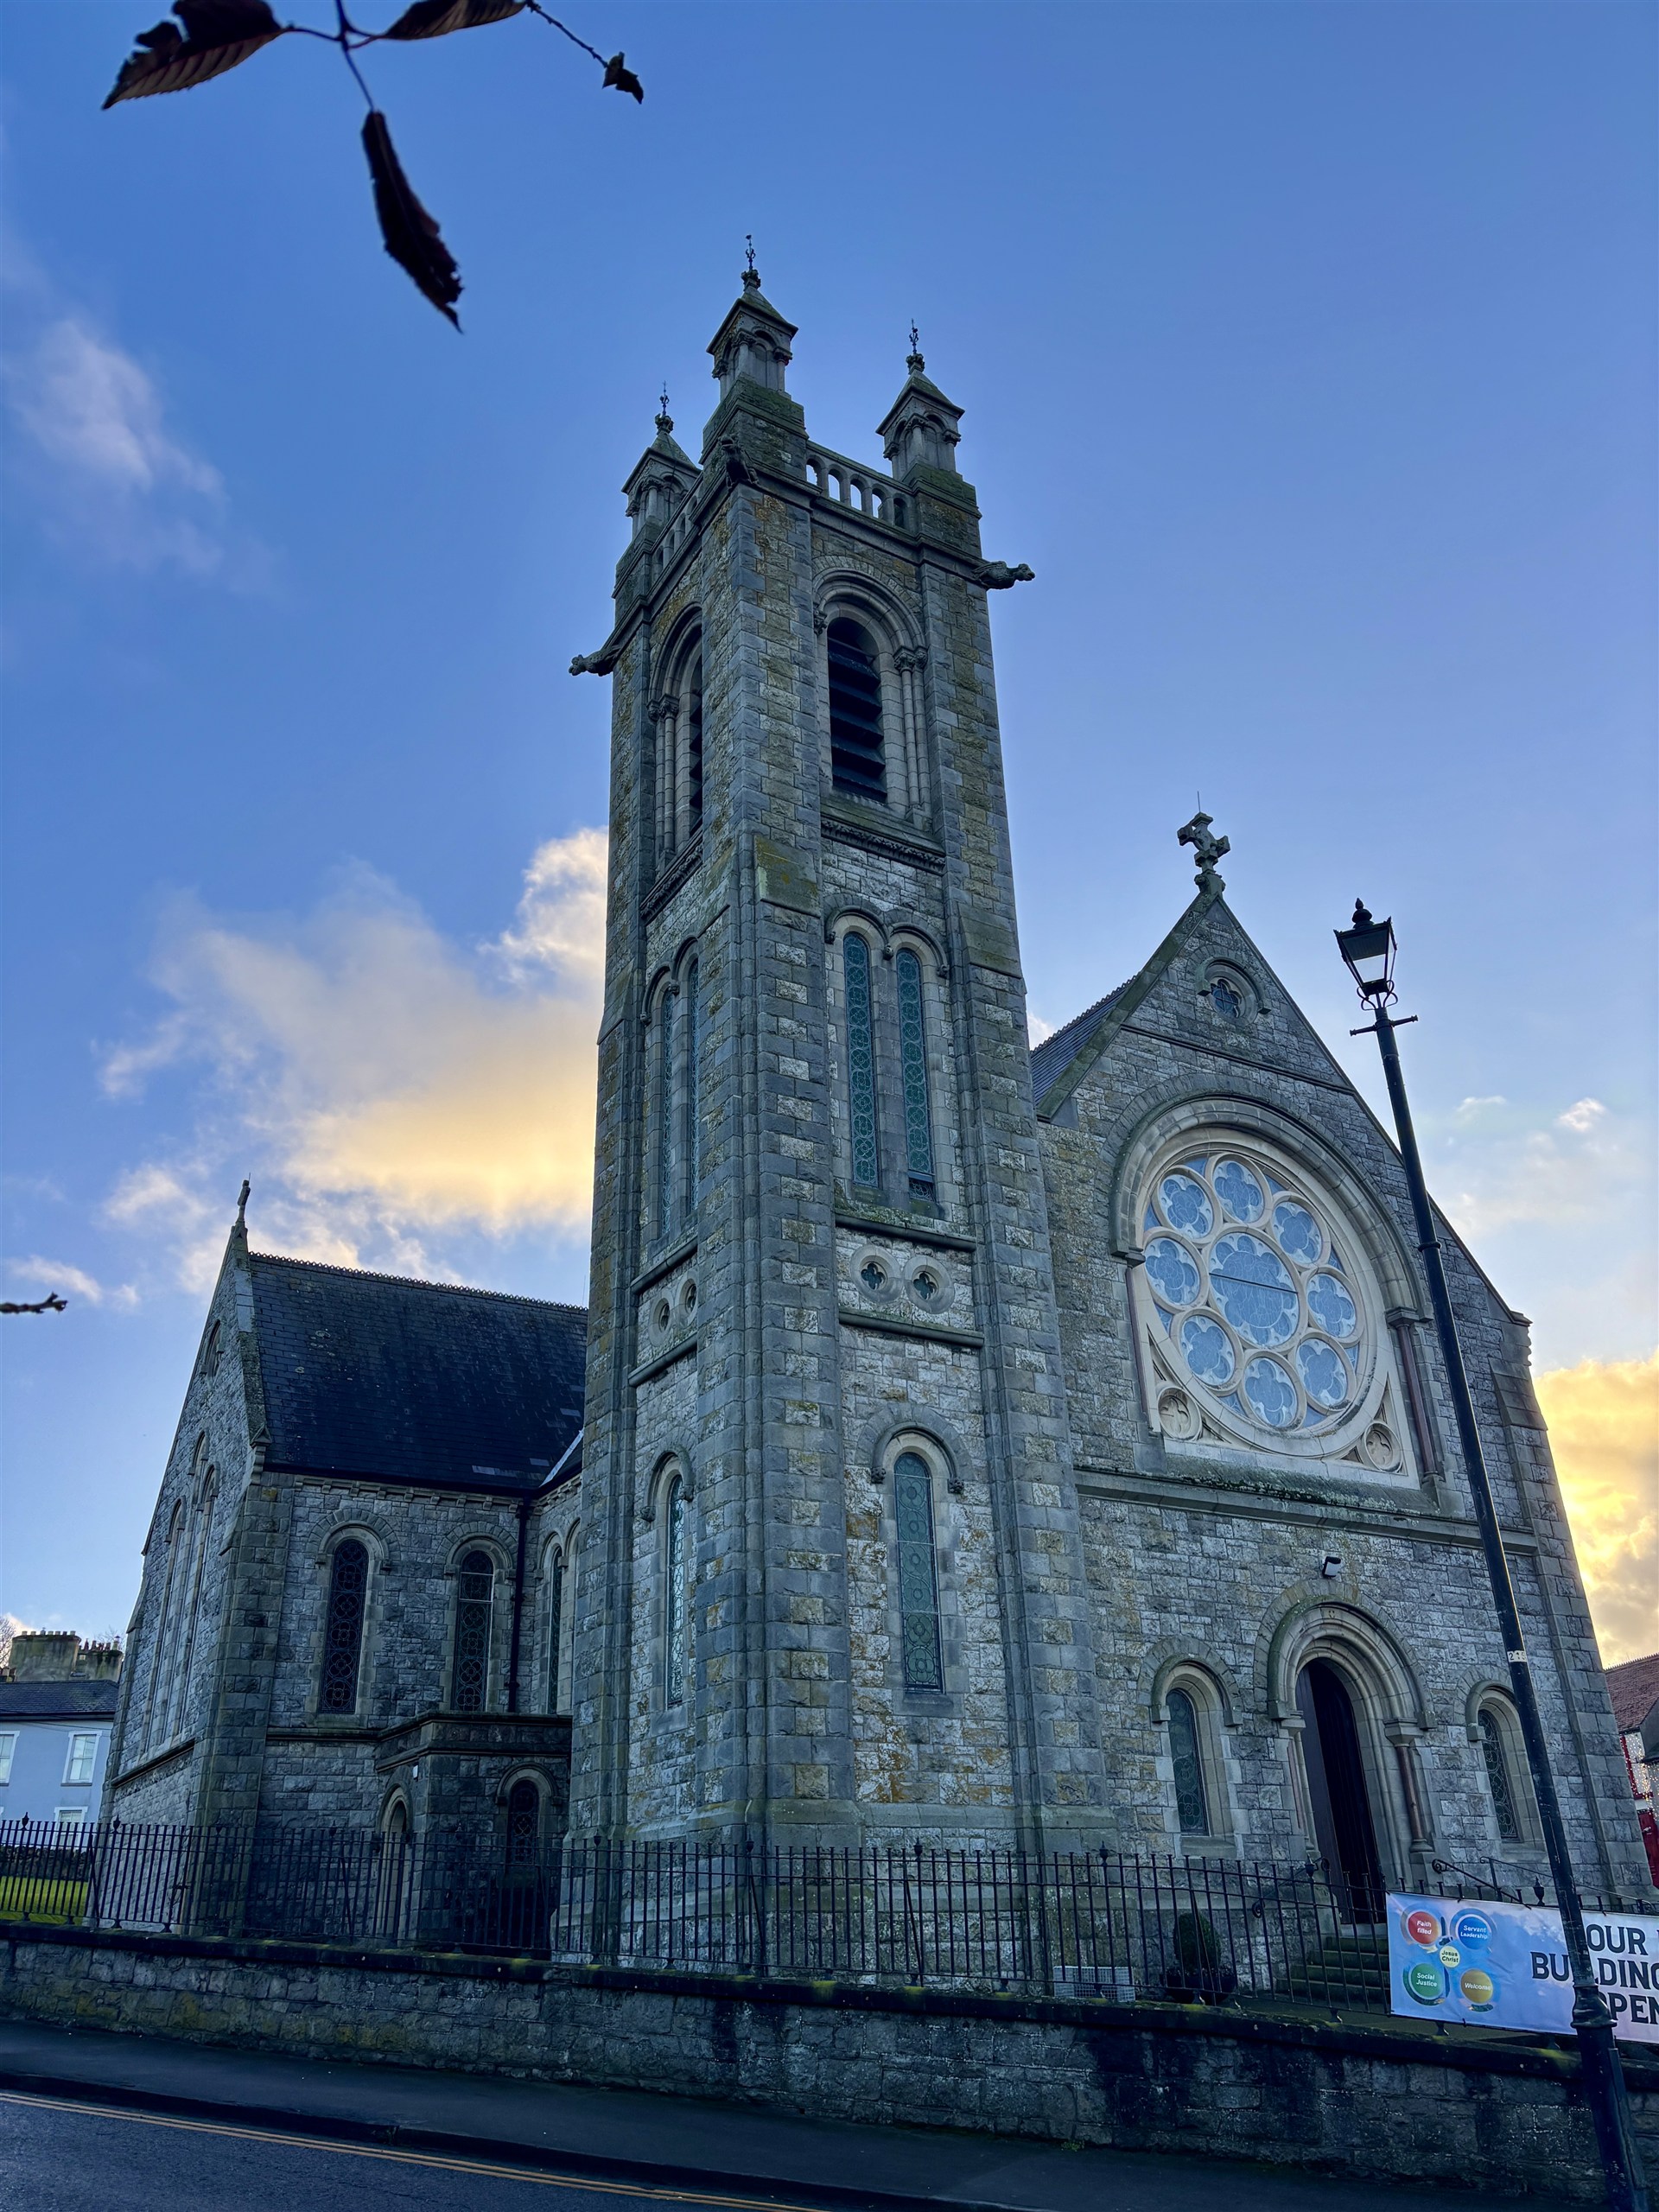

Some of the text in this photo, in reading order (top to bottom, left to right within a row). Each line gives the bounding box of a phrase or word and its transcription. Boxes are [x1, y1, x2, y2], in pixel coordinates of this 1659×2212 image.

[1460, 1931, 1488, 1940] Leadership
[1530, 1951, 1659, 1990] BUDIN
[1416, 1979, 1438, 1987] Justice
[1465, 1982, 1491, 1991] Welcome
